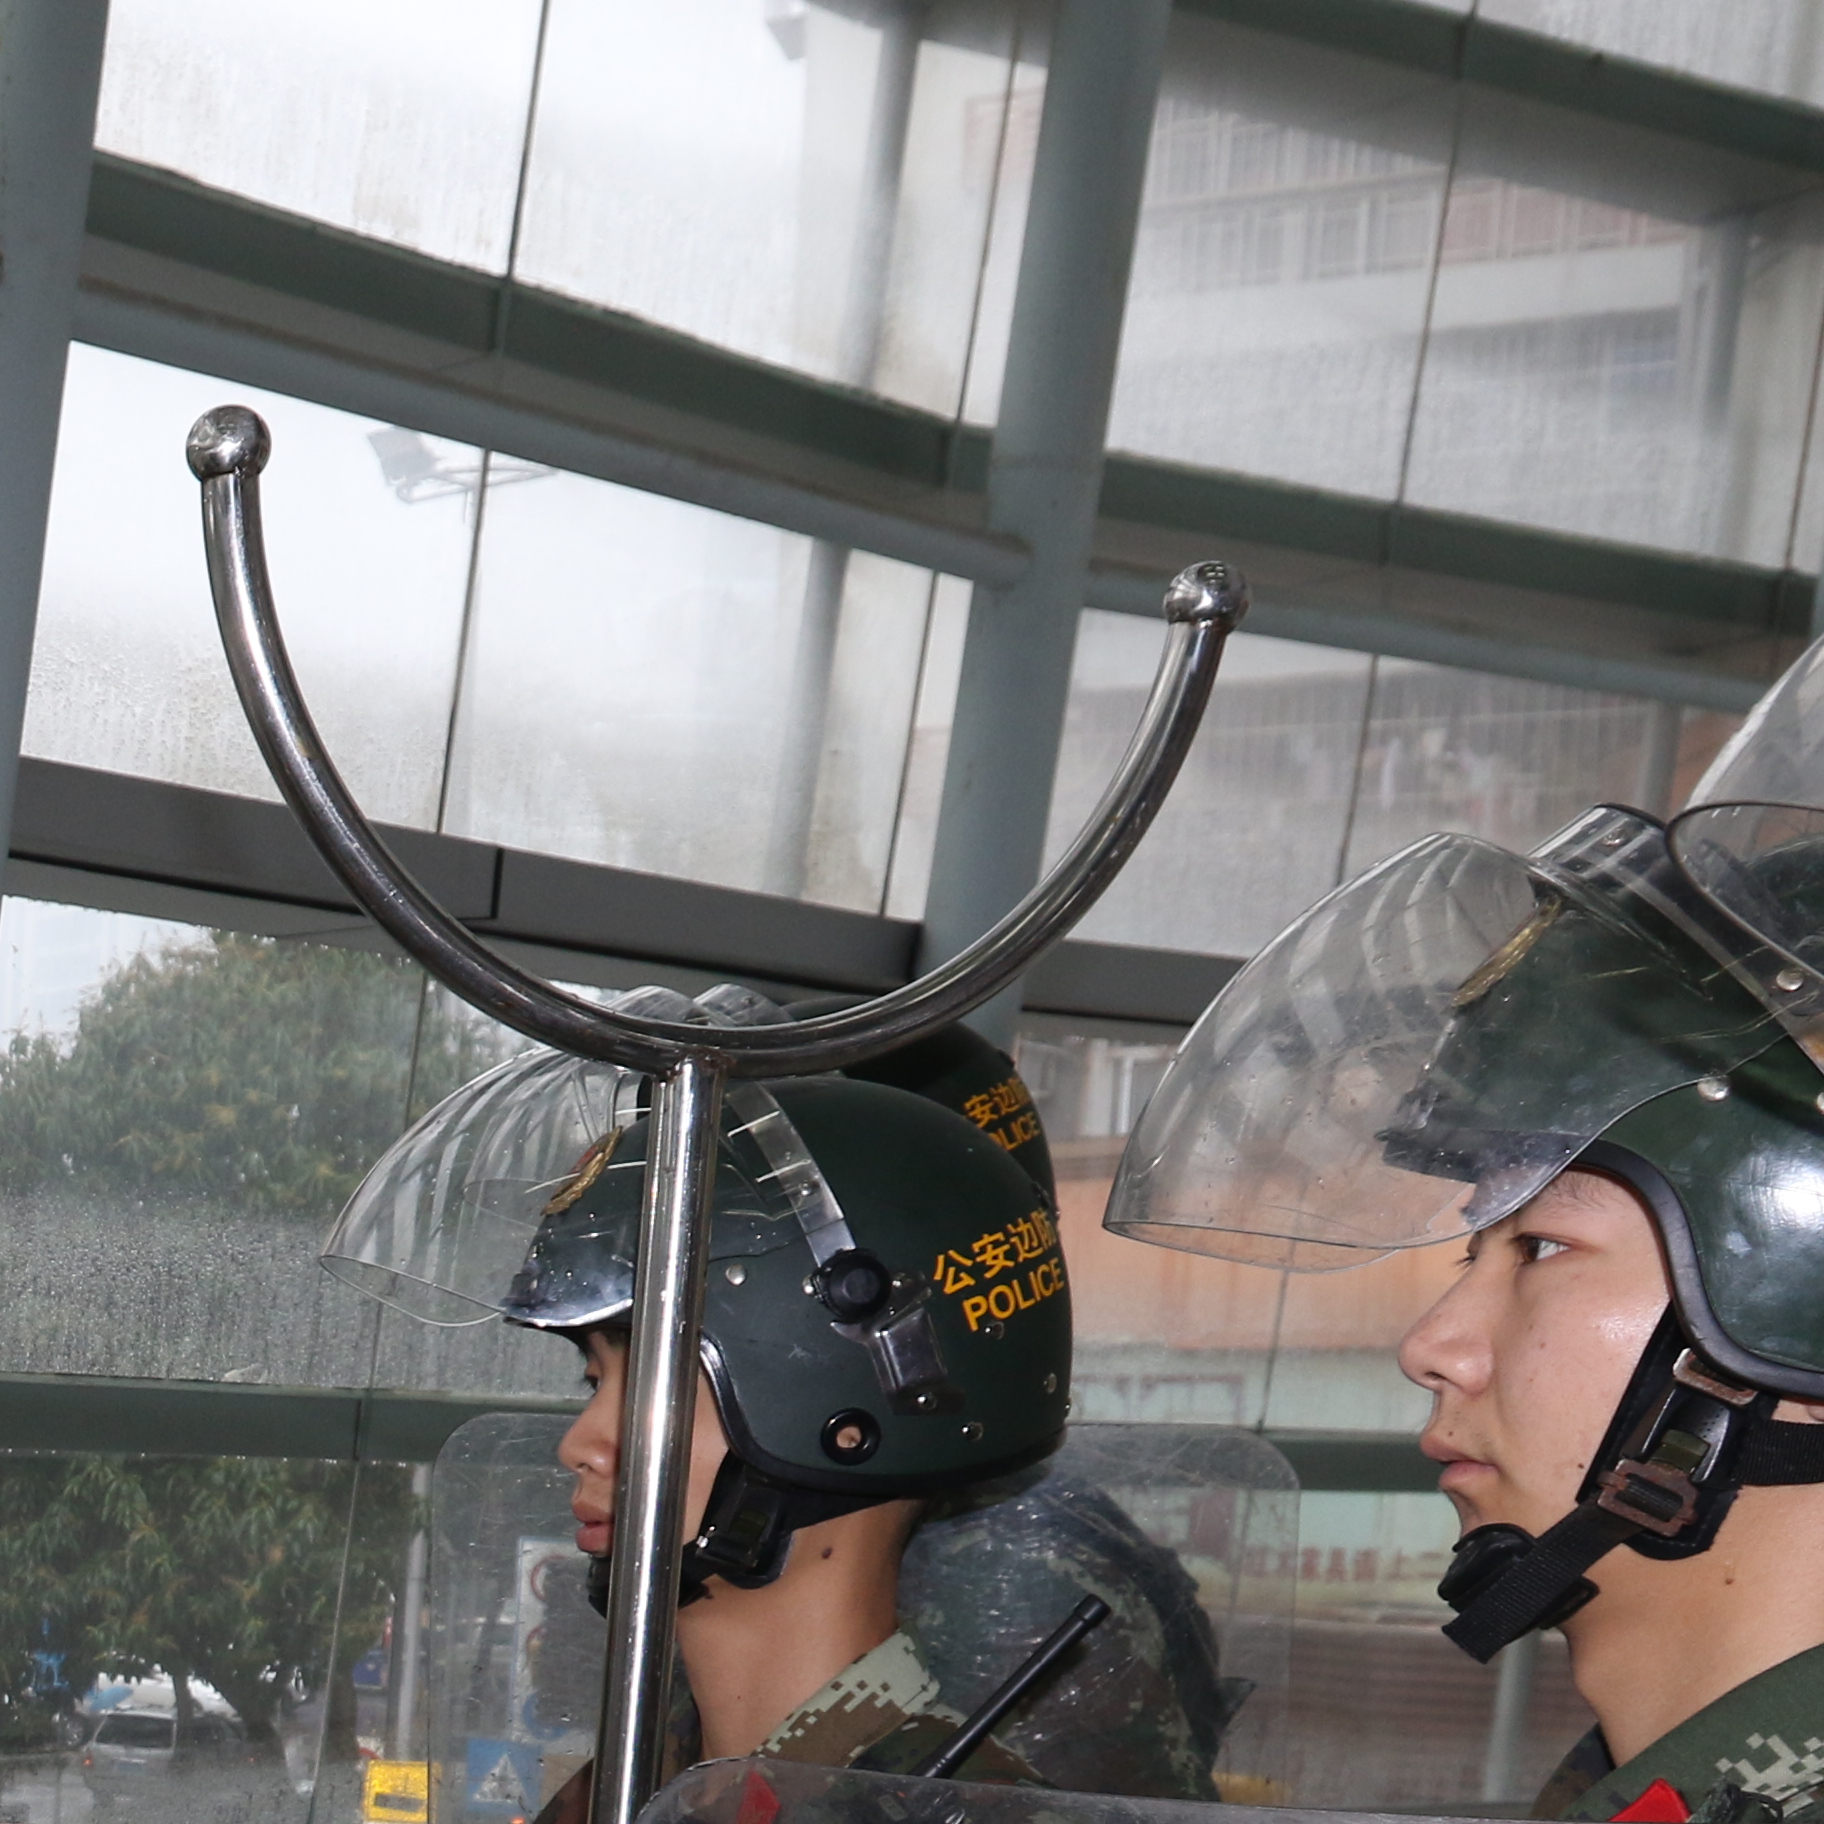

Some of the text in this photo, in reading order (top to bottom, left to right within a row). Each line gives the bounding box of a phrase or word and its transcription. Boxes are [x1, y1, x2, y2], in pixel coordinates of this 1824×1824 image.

[933, 1207, 1056, 1294] 公安边防
[963, 1257, 1063, 1331] POLICE
